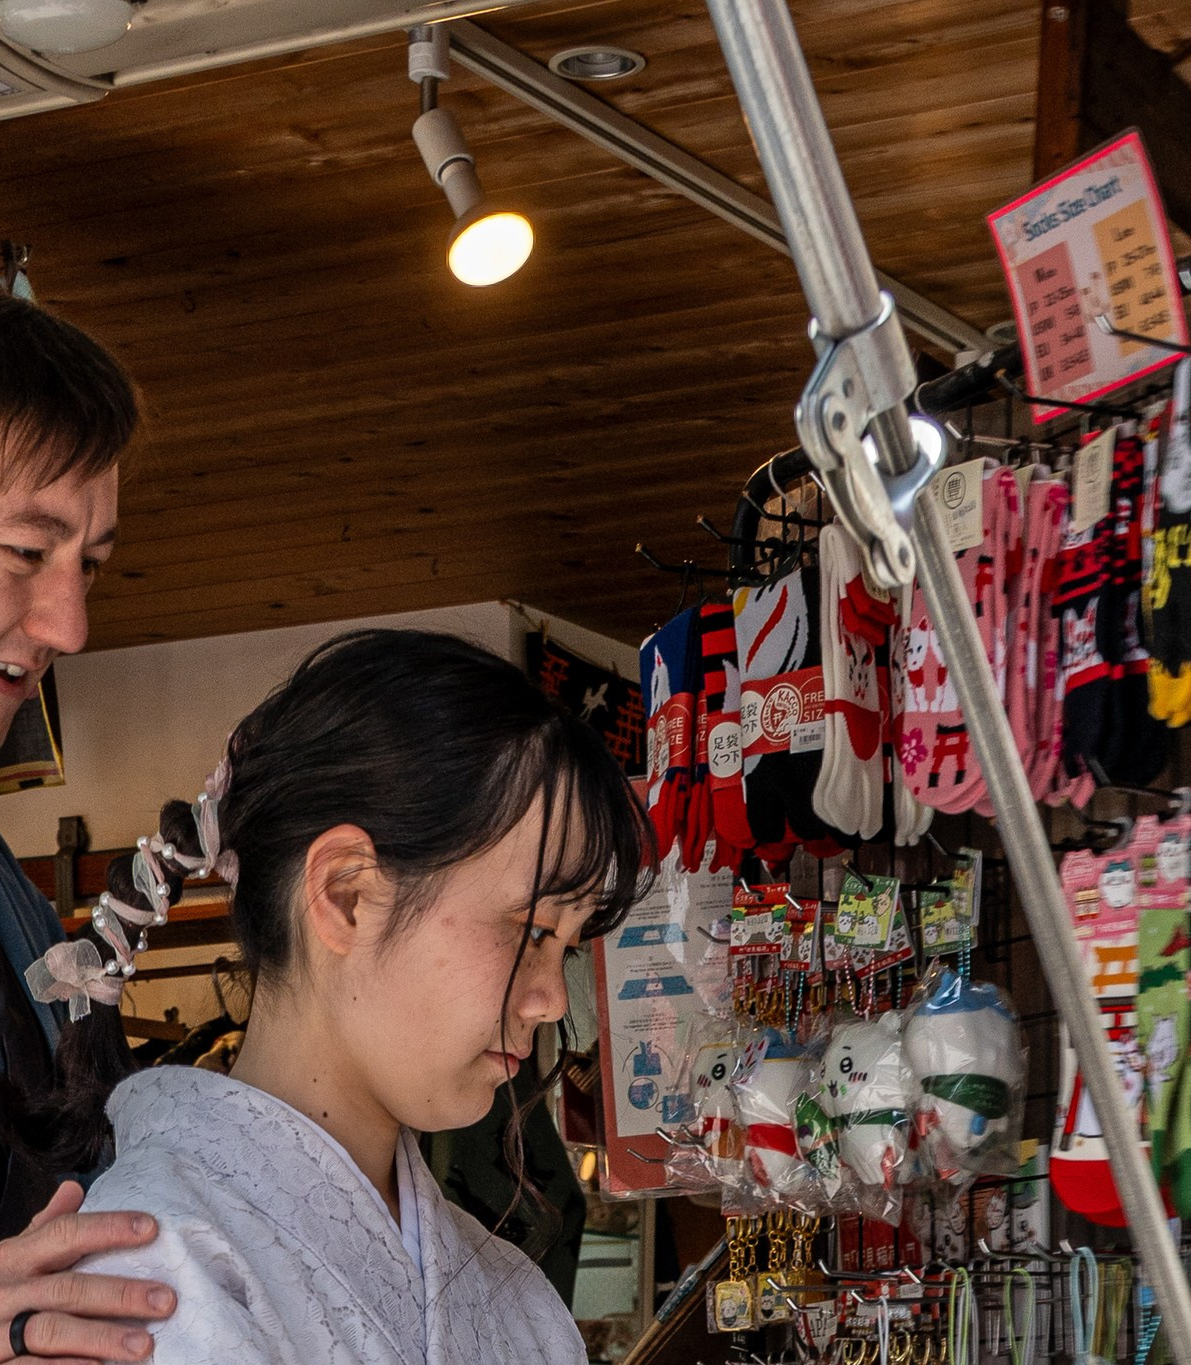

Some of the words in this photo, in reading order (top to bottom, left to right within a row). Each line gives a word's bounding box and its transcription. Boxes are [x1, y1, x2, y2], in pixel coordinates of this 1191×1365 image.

[1022, 211, 1060, 242] Socks
[803, 690, 825, 704] FRE
[803, 708, 824, 722] SIZ
[713, 733, 739, 750] 足袋
[712, 750, 740, 767] くつ下
